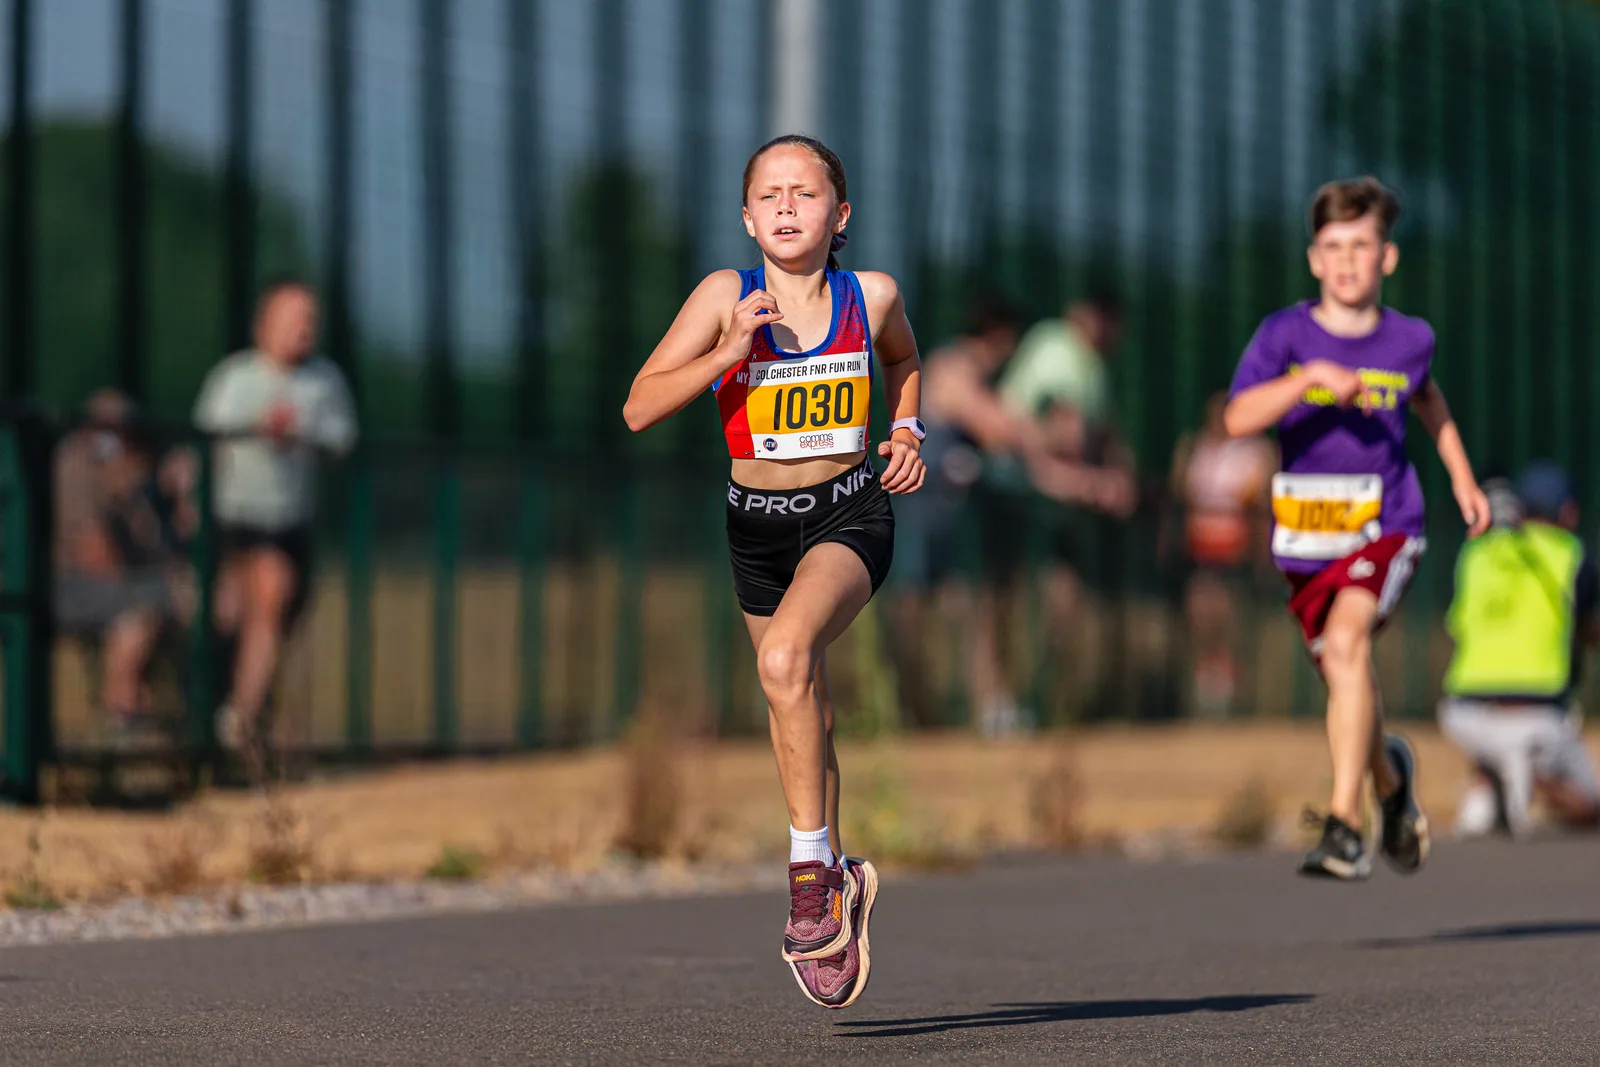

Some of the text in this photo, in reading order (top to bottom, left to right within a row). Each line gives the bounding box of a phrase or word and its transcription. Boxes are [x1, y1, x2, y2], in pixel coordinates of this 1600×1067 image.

[756, 360, 861, 380] COLCHESTER FNR FUN RUN
[774, 382, 853, 430] 1030
[799, 433, 834, 443] comms
[800, 440, 834, 449] express
[728, 454, 874, 515] E PRO NIK
[795, 873, 816, 883] HOKA
